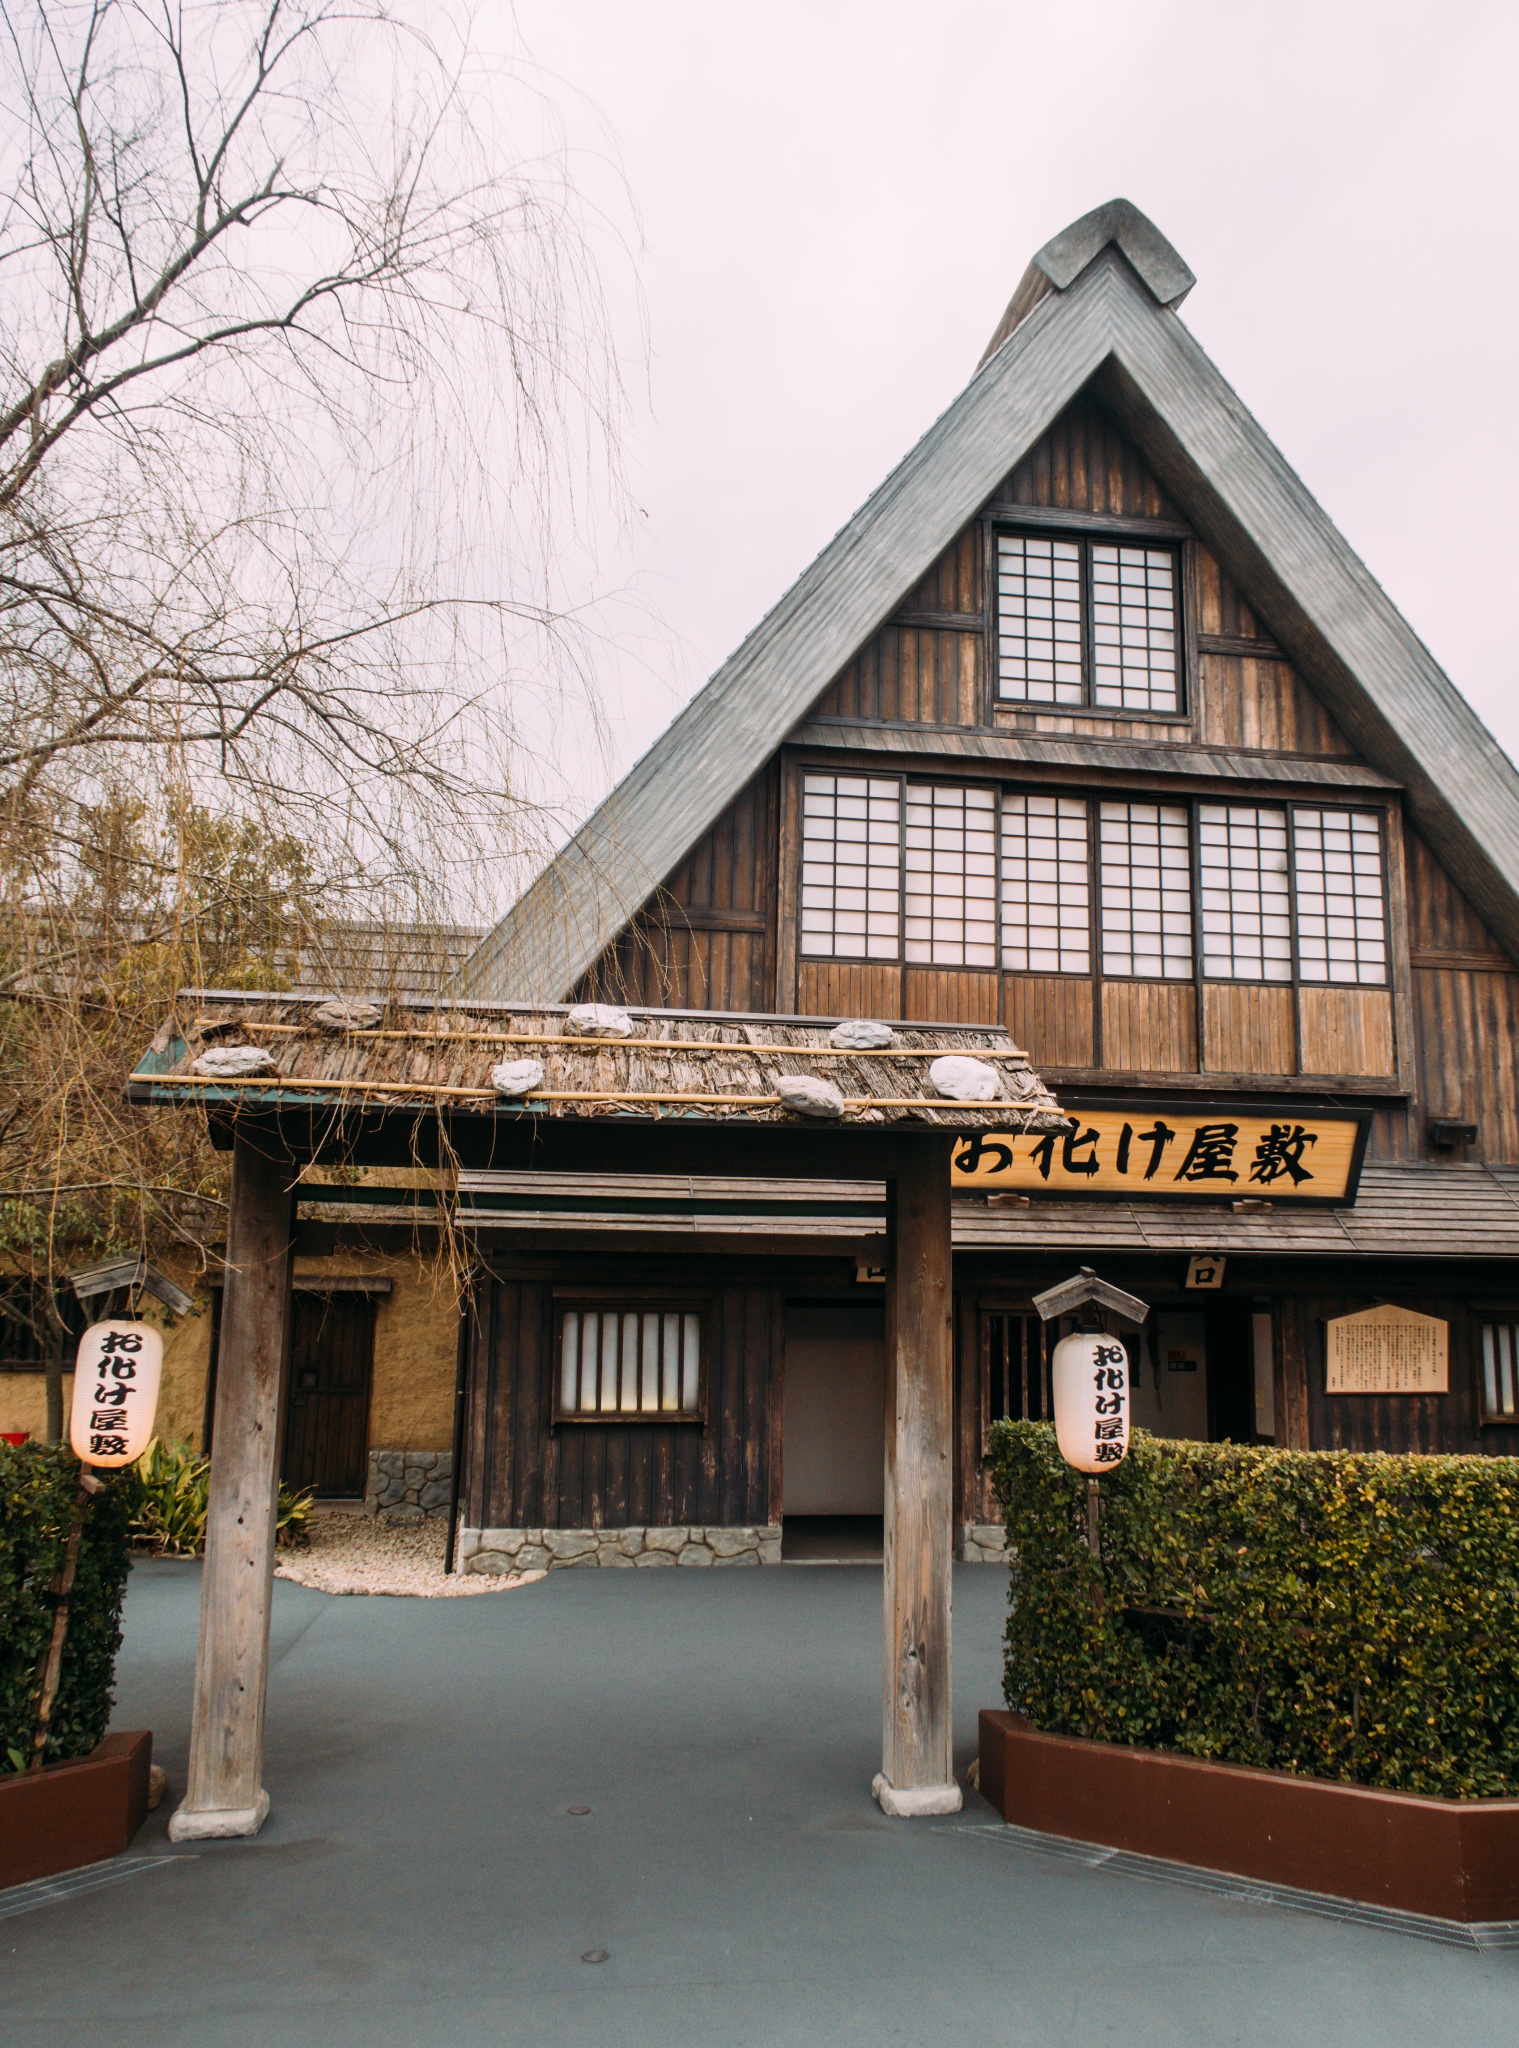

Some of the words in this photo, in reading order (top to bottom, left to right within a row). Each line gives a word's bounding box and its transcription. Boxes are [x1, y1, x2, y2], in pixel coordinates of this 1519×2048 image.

[951, 1116, 1318, 1187] お化け屋敷
[89, 1331, 144, 1456] お化け屋敷
[1092, 1345, 1126, 1463] お化け屋敷
